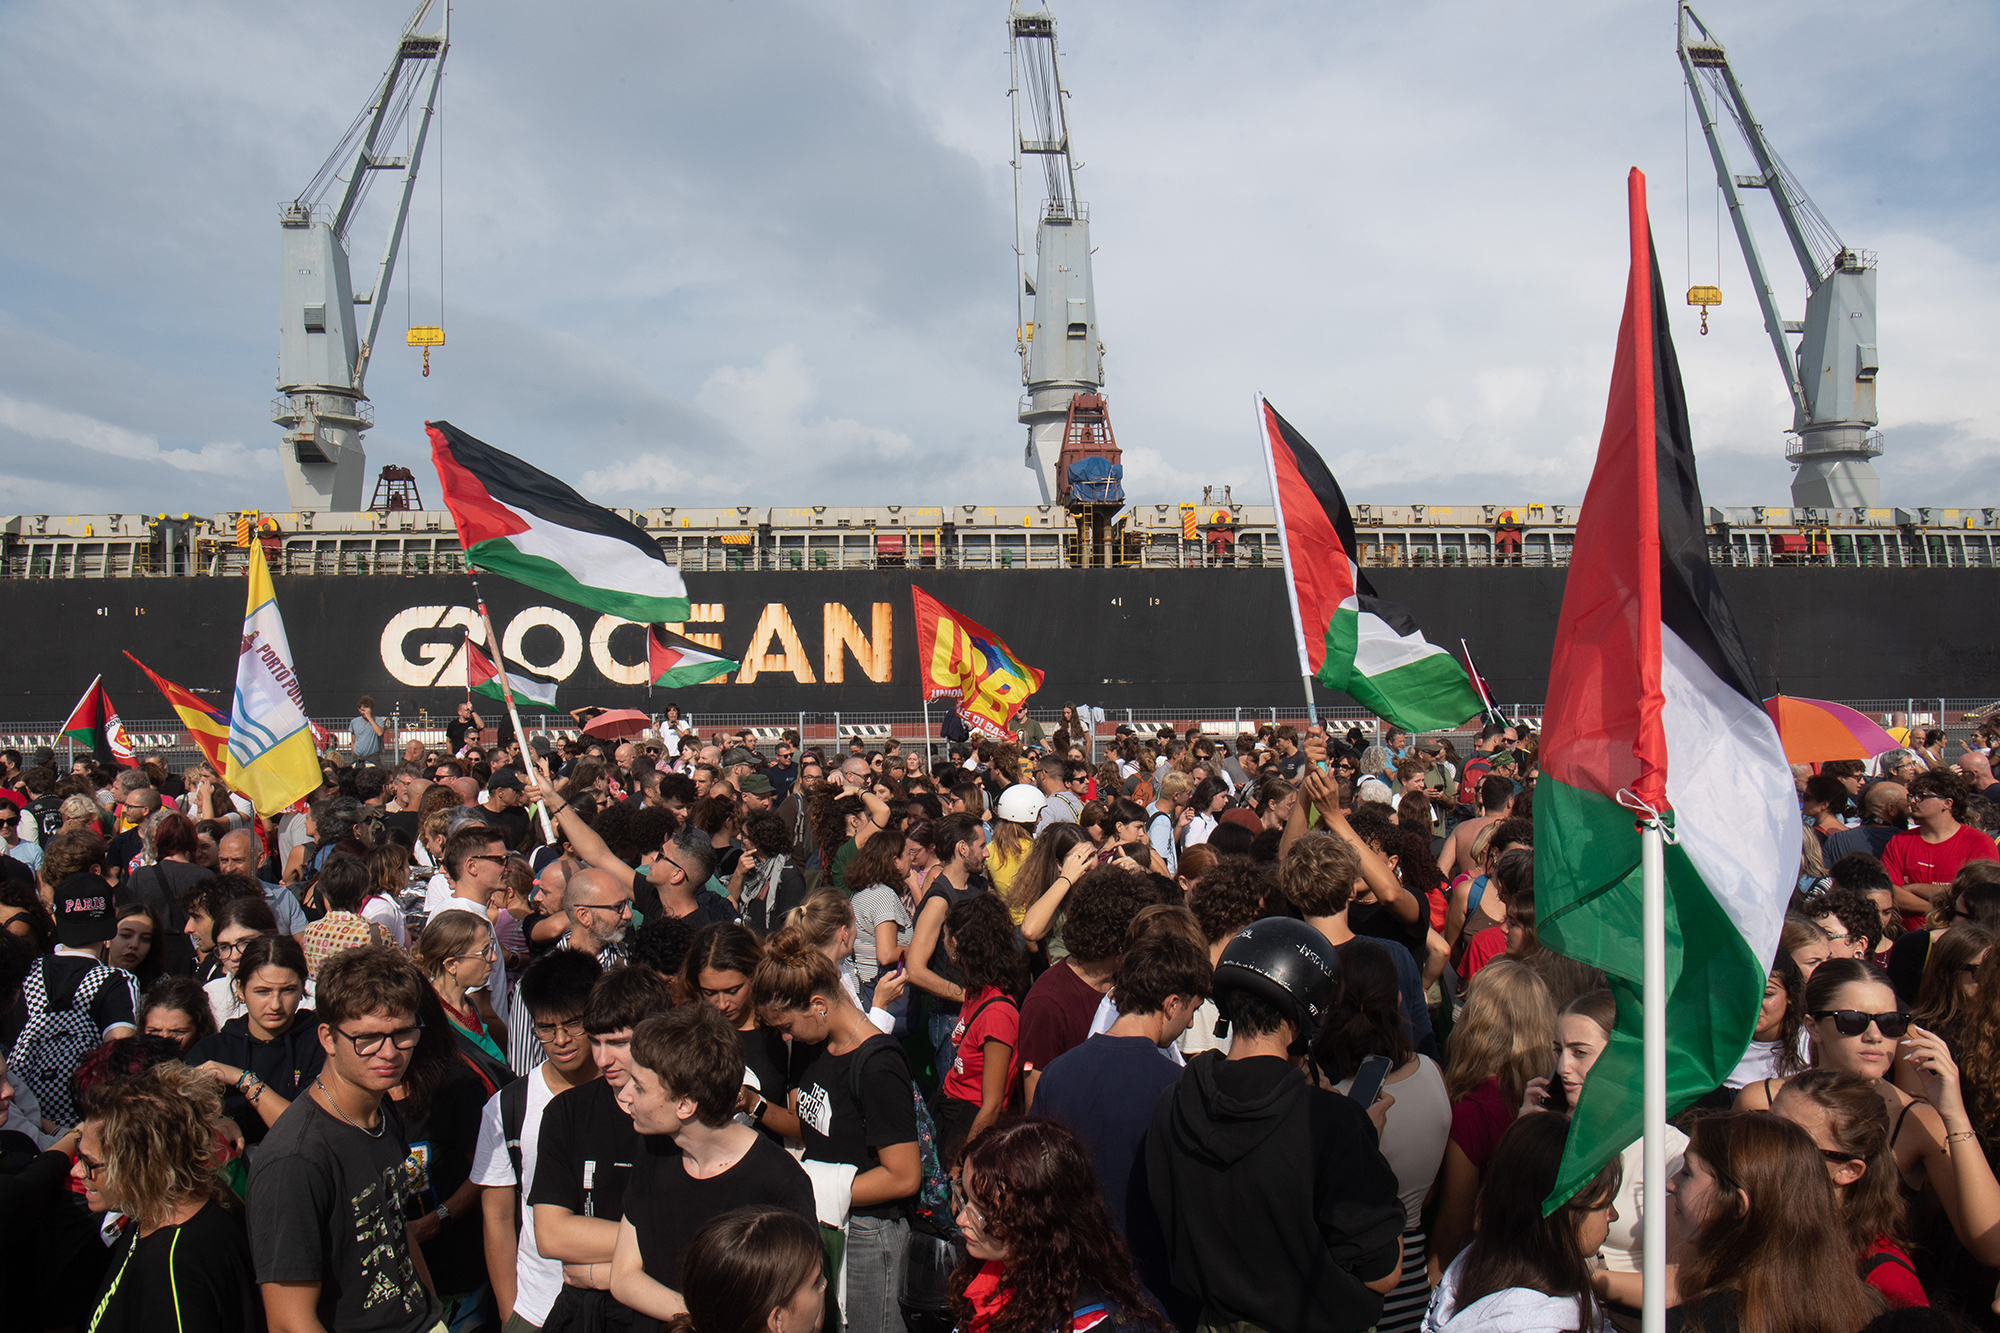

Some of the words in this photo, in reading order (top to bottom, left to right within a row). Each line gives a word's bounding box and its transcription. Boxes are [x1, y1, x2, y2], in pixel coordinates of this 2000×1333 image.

[724, 509, 736, 517] 15
[790, 508, 814, 517] (14)
[917, 508, 940, 516] 4HS
[1429, 507, 1451, 515] 3HS
[1869, 509, 1890, 517] 2HS
[1945, 509, 1958, 517] 05
[284, 513, 297, 521] 19
[256, 642, 290, 682] PORTO
[65, 896, 106, 913] PARIS
[811, 1082, 826, 1102] THE
[797, 1087, 822, 1115] NORTH
[799, 1105, 817, 1128] FACE
